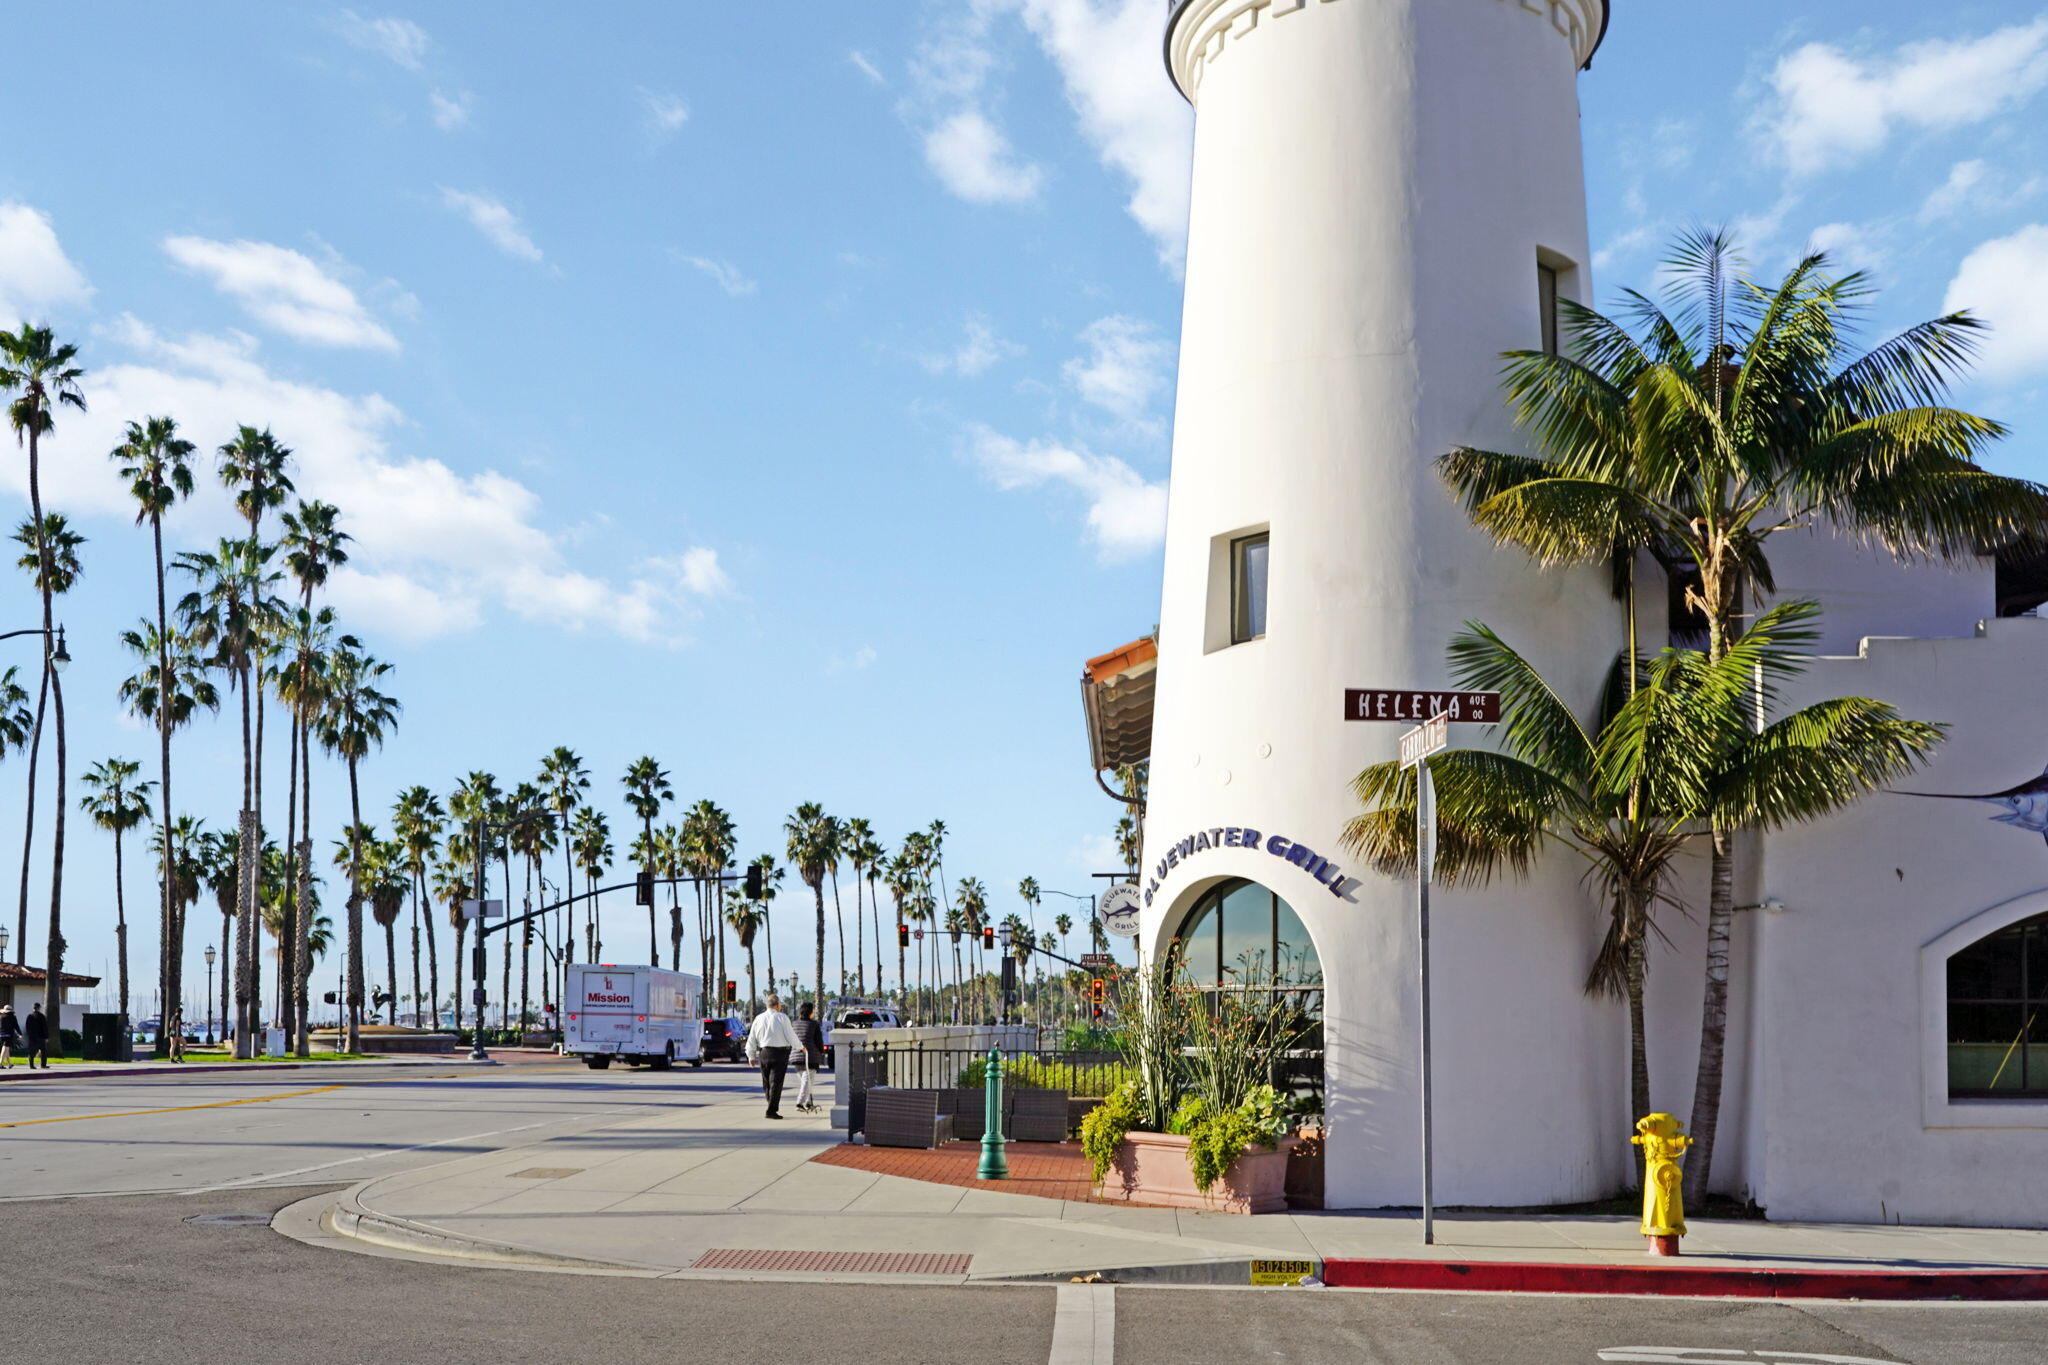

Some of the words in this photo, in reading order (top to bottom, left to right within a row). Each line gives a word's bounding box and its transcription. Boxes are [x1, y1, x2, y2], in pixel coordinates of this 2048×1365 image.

[1358, 693, 1460, 719] HELENA
[1470, 695, 1486, 706] AVE
[1145, 827, 1261, 908] BLUEWATER
[1266, 835, 1346, 898] GRILL
[1103, 888, 1140, 908] BLUEWATE
[1114, 920, 1140, 930] GRILL
[587, 992, 631, 1003] Mission
[1252, 1260, 1310, 1273] M5029505
